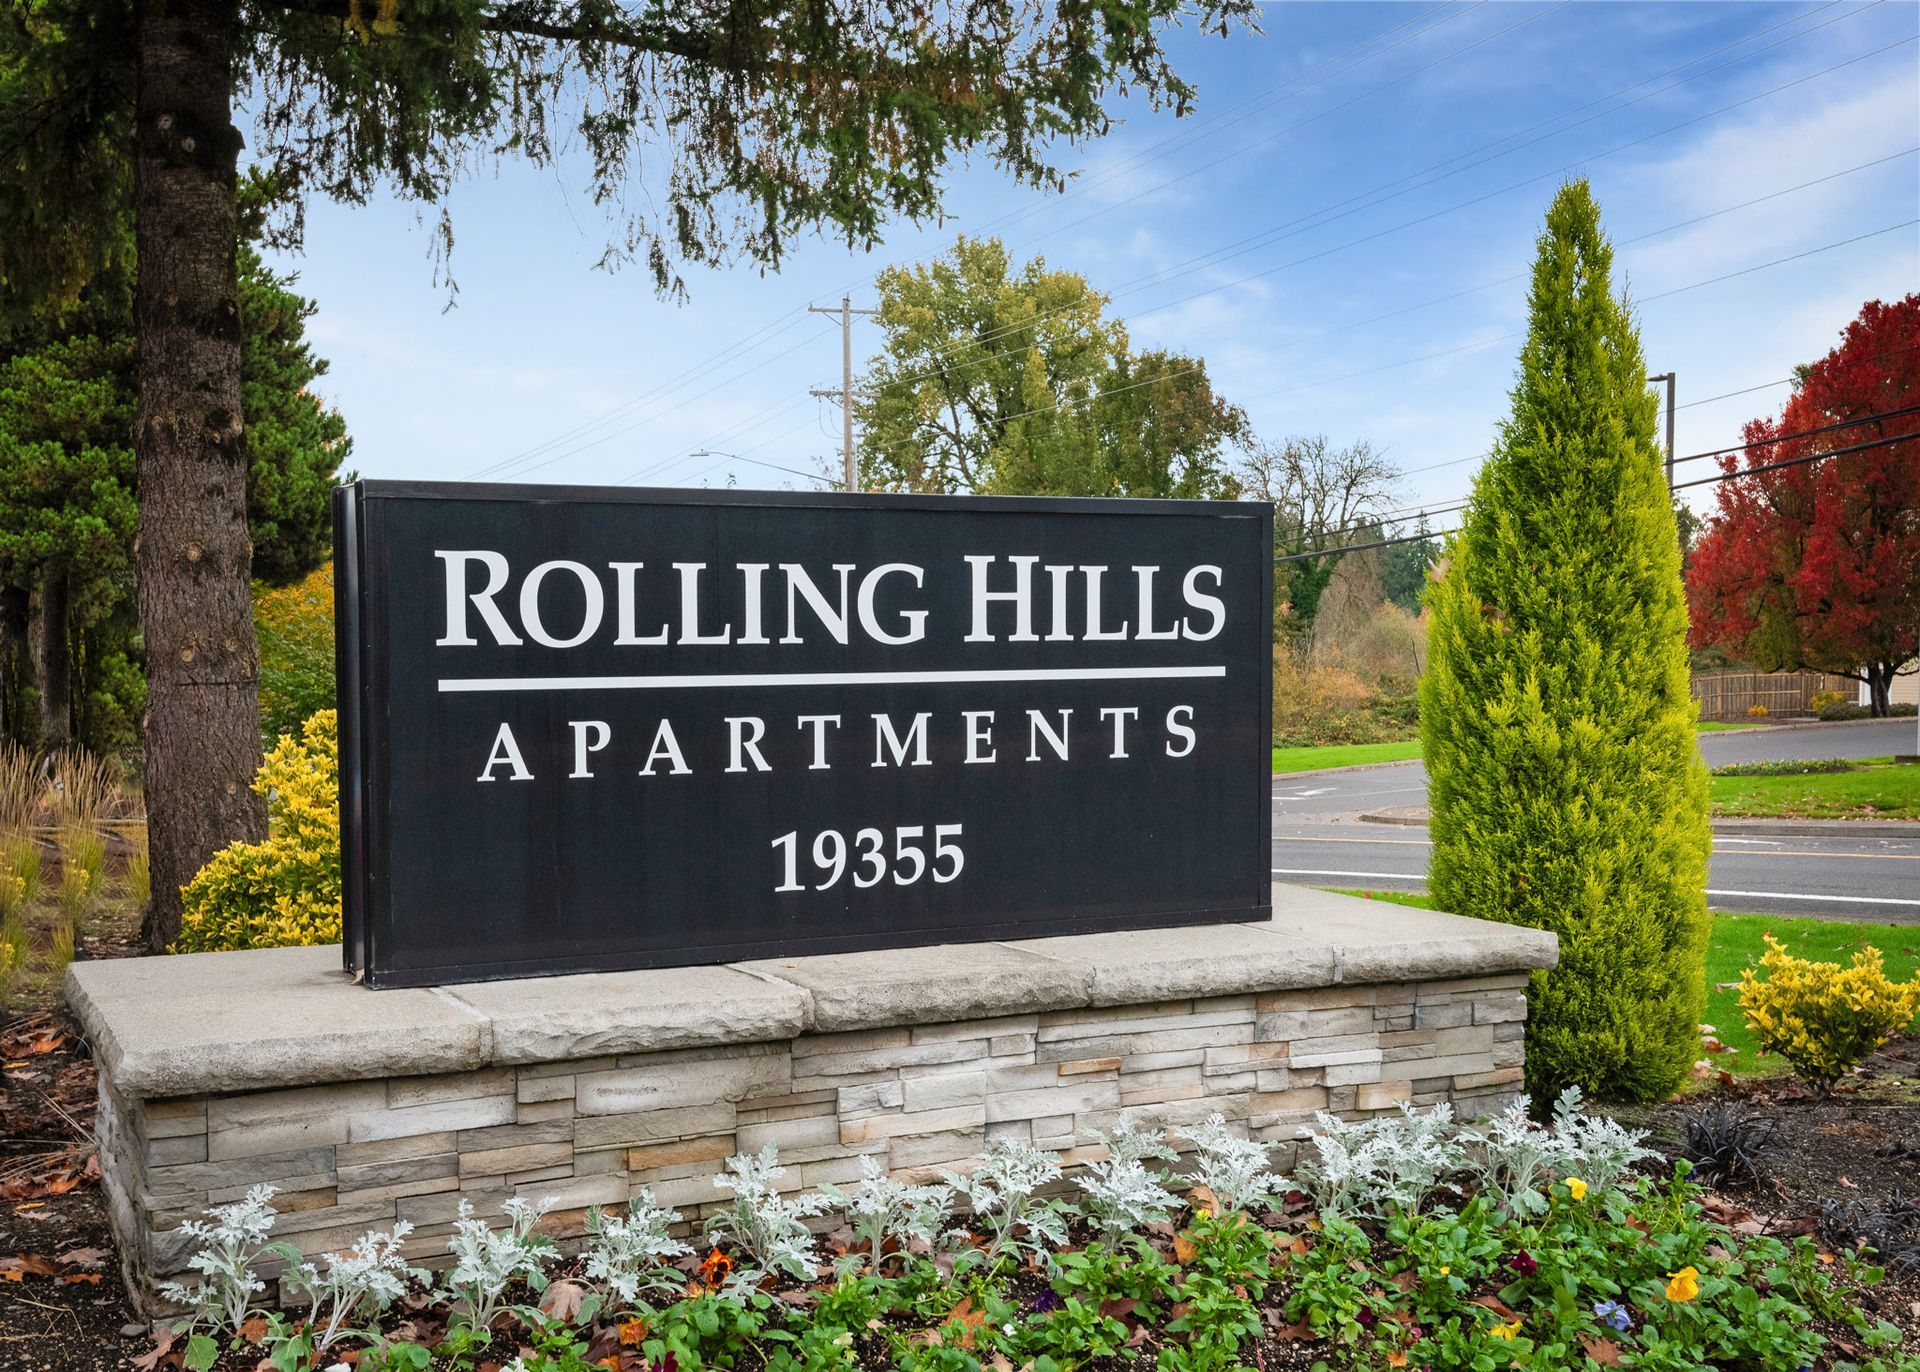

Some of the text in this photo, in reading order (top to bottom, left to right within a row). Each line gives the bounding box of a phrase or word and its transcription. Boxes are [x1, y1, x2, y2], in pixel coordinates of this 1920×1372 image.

[434, 549, 1226, 649] ROLLING HILLS
[476, 704, 1196, 782] APARTMENTS
[771, 823, 965, 893] 19355
